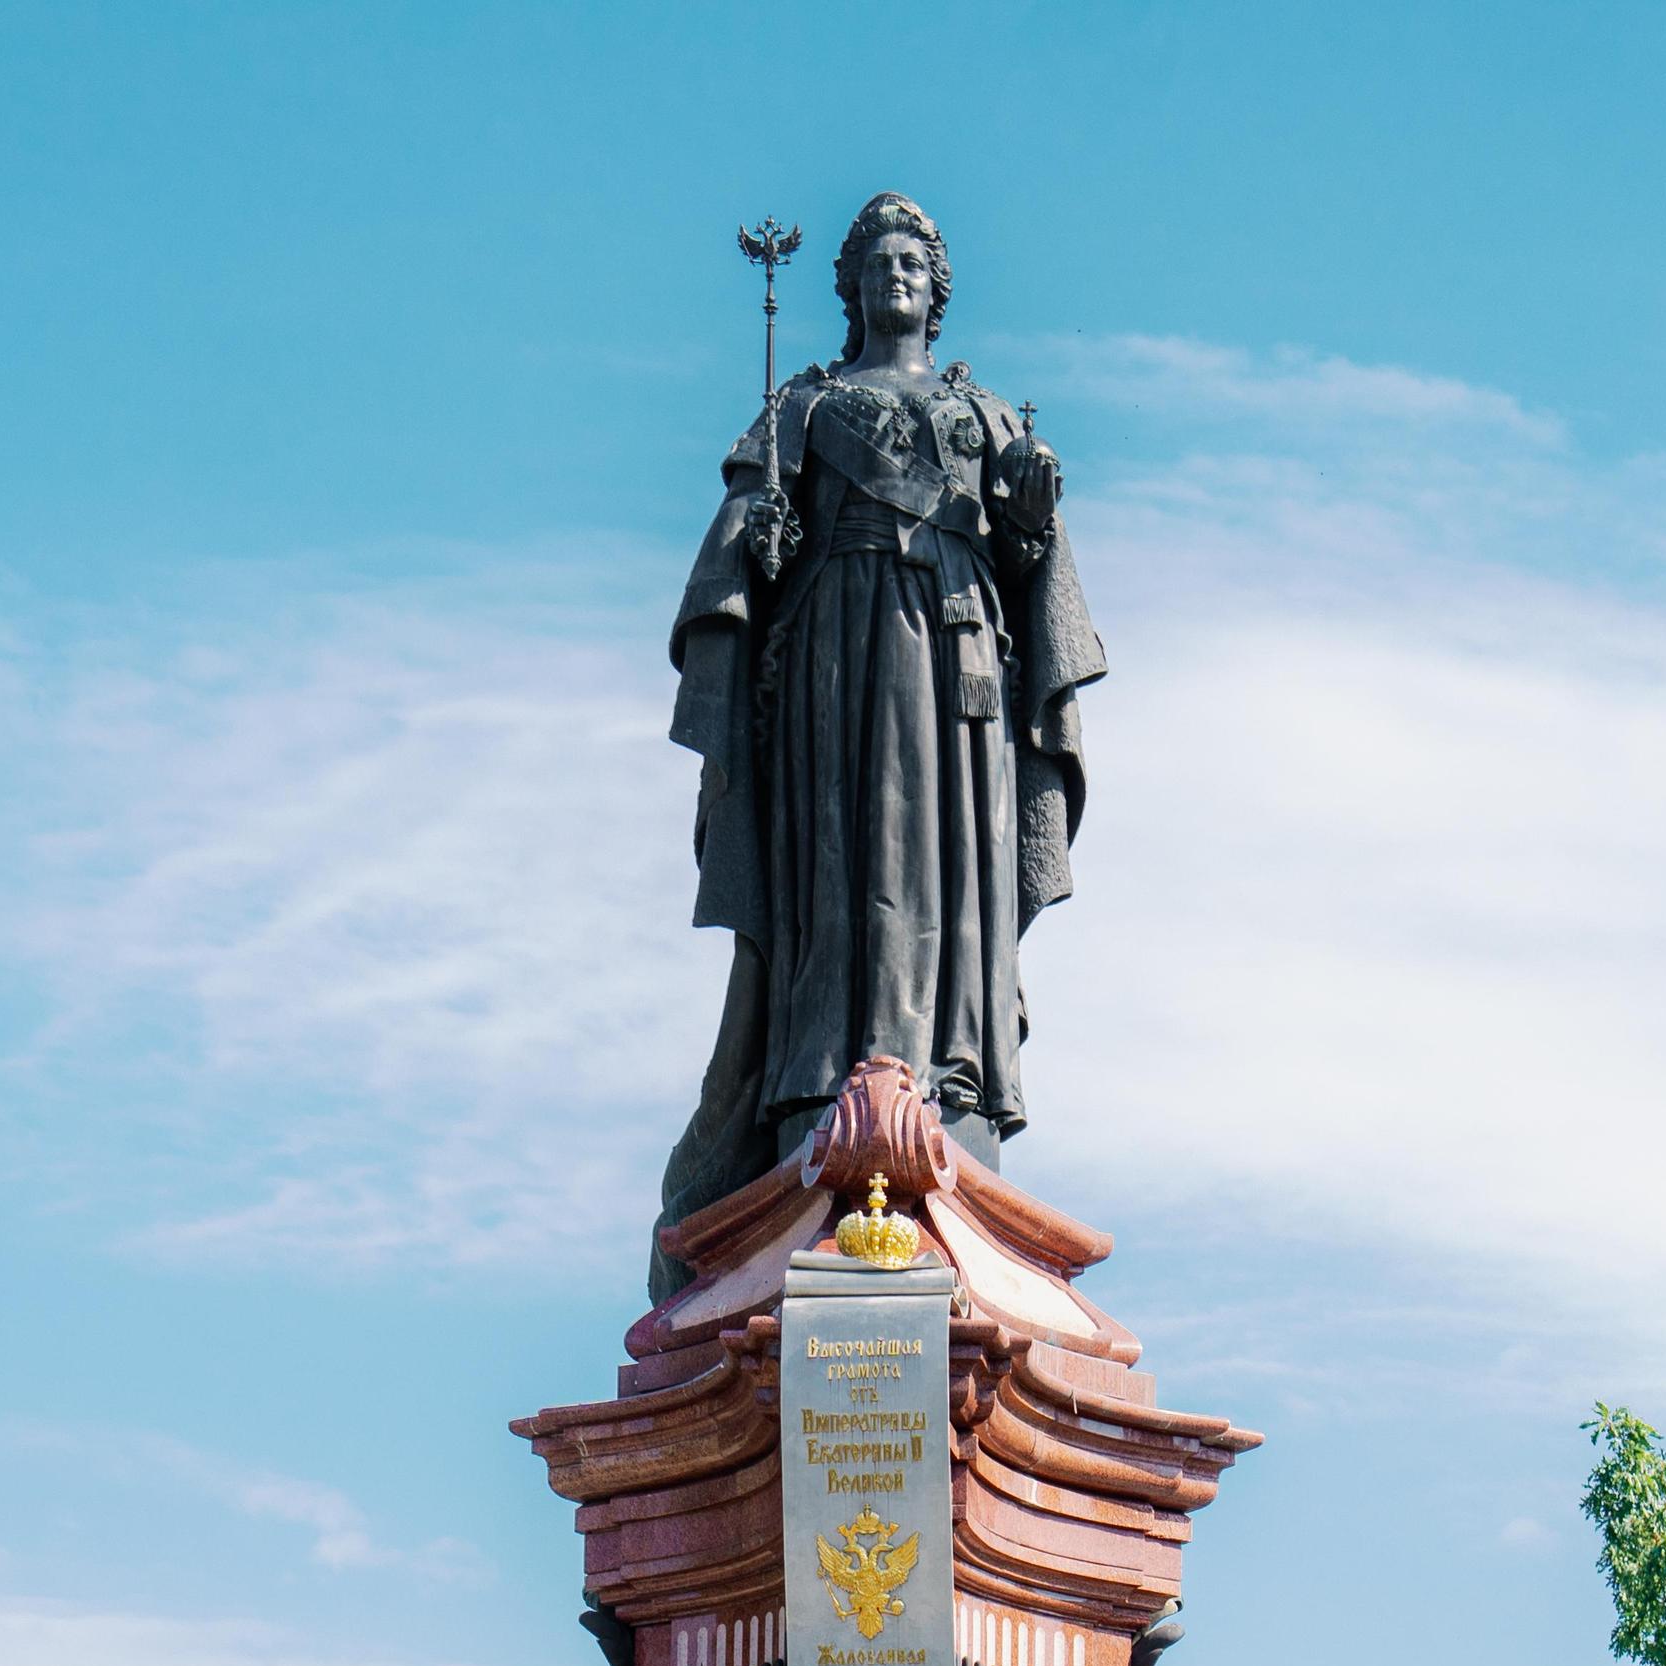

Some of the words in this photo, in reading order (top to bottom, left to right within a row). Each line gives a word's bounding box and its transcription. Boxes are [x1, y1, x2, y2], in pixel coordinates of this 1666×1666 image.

[807, 1335, 922, 1358] Высочайшая
[828, 1363, 901, 1379] грамота
[801, 1408, 926, 1433] Императрицы
[806, 1438, 907, 1464] Екатерины
[827, 1468, 904, 1494] Великой
